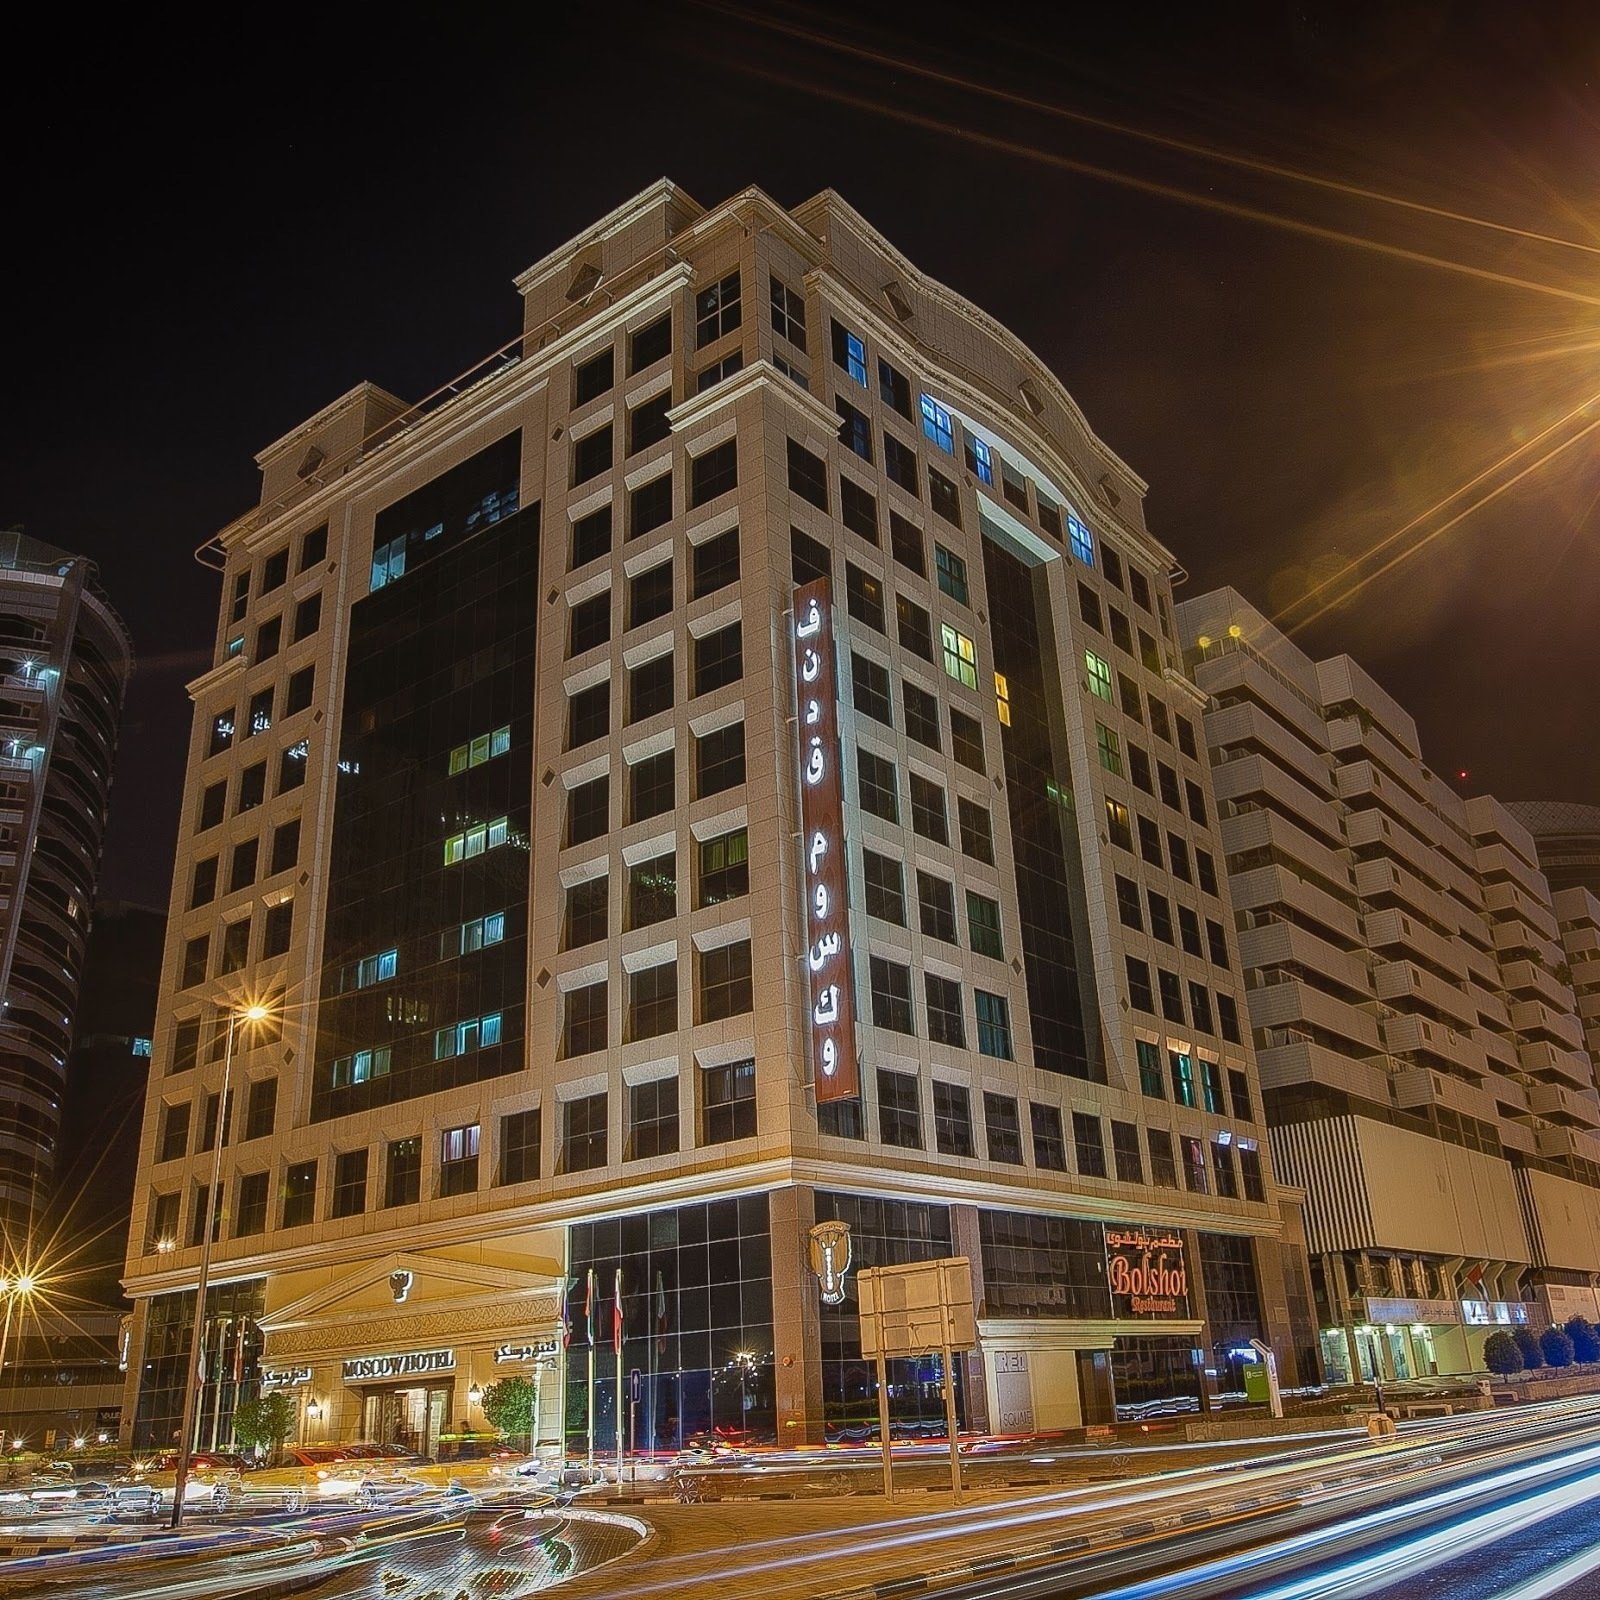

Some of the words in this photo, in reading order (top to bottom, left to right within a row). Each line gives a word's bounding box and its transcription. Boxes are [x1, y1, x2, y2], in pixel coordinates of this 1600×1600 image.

[1149, 1234, 1183, 1250] مطعم
[1110, 1252, 1188, 1296] Bolshoi
[1131, 1297, 1176, 1313] Restaurant
[342, 1357, 403, 1378] MOSCOW
[403, 1351, 455, 1371] HOTEL
